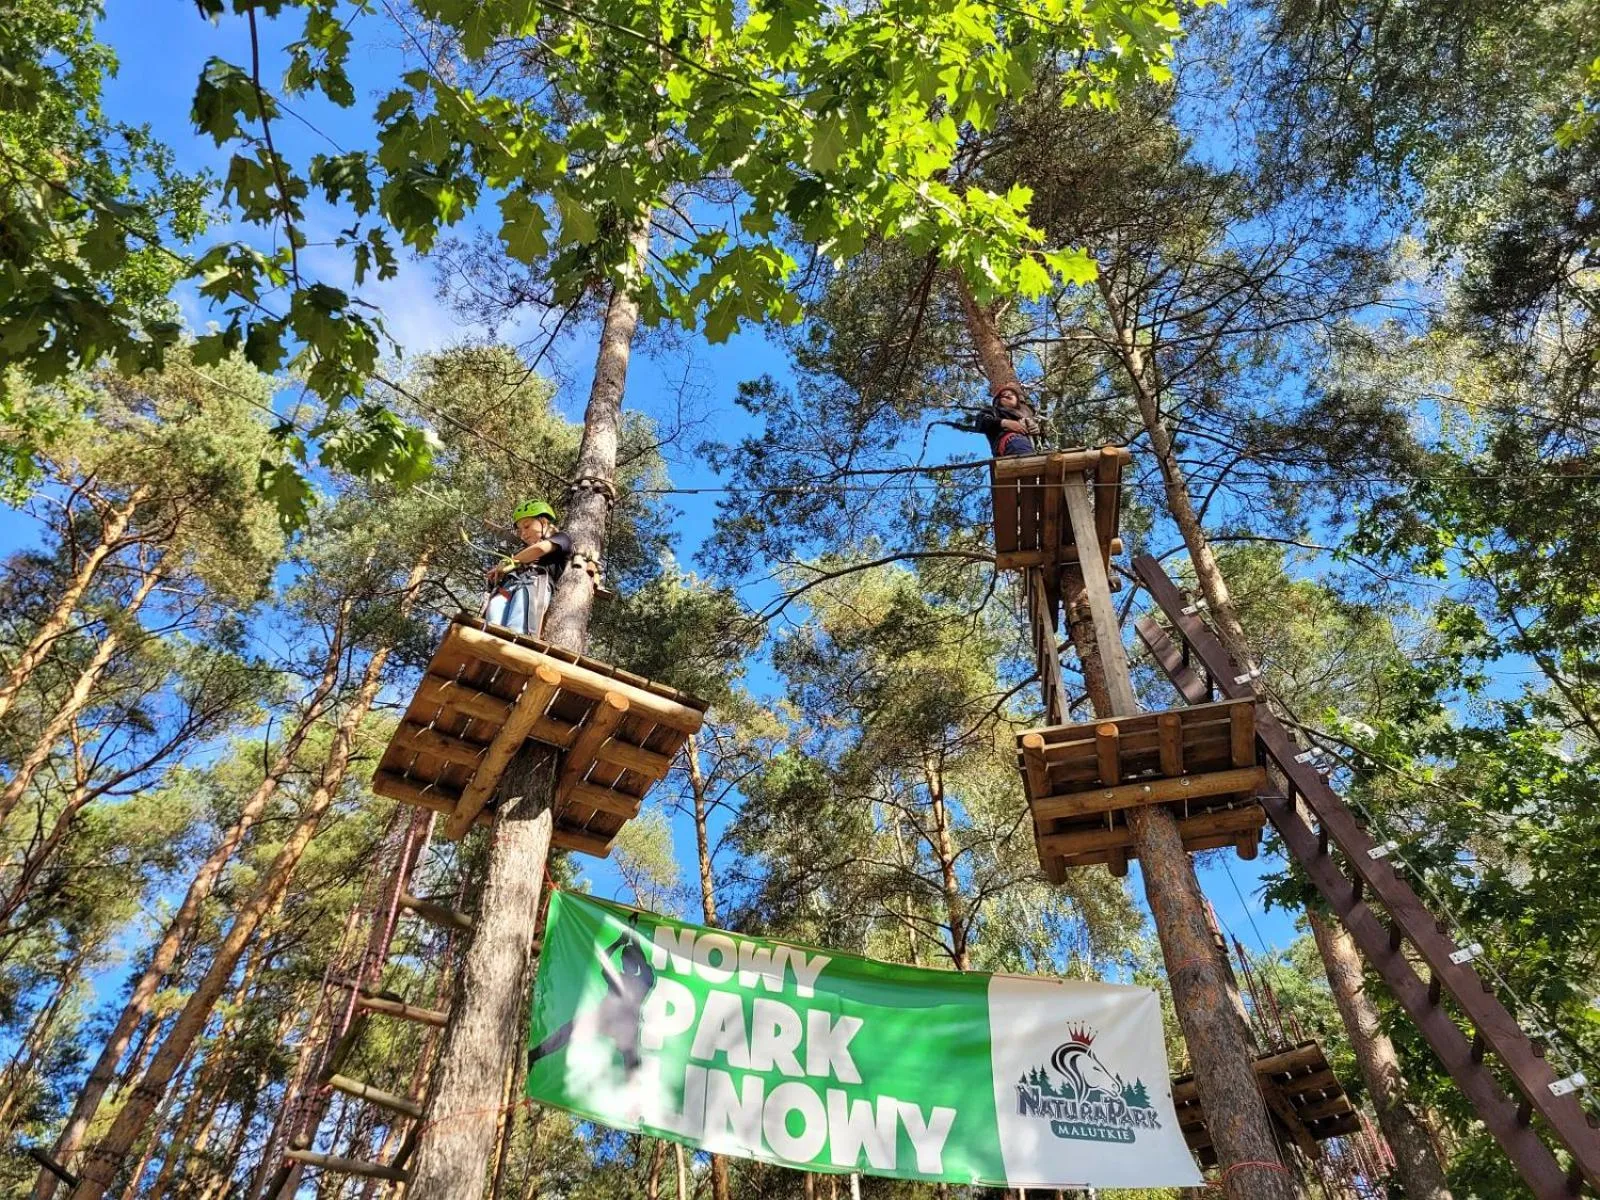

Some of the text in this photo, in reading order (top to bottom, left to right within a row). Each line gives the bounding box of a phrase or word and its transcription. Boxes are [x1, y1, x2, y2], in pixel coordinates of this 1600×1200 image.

[652, 926, 831, 997] NOWY
[640, 977, 863, 1084] PARK
[1058, 1124, 1130, 1141] MALUTKIE
